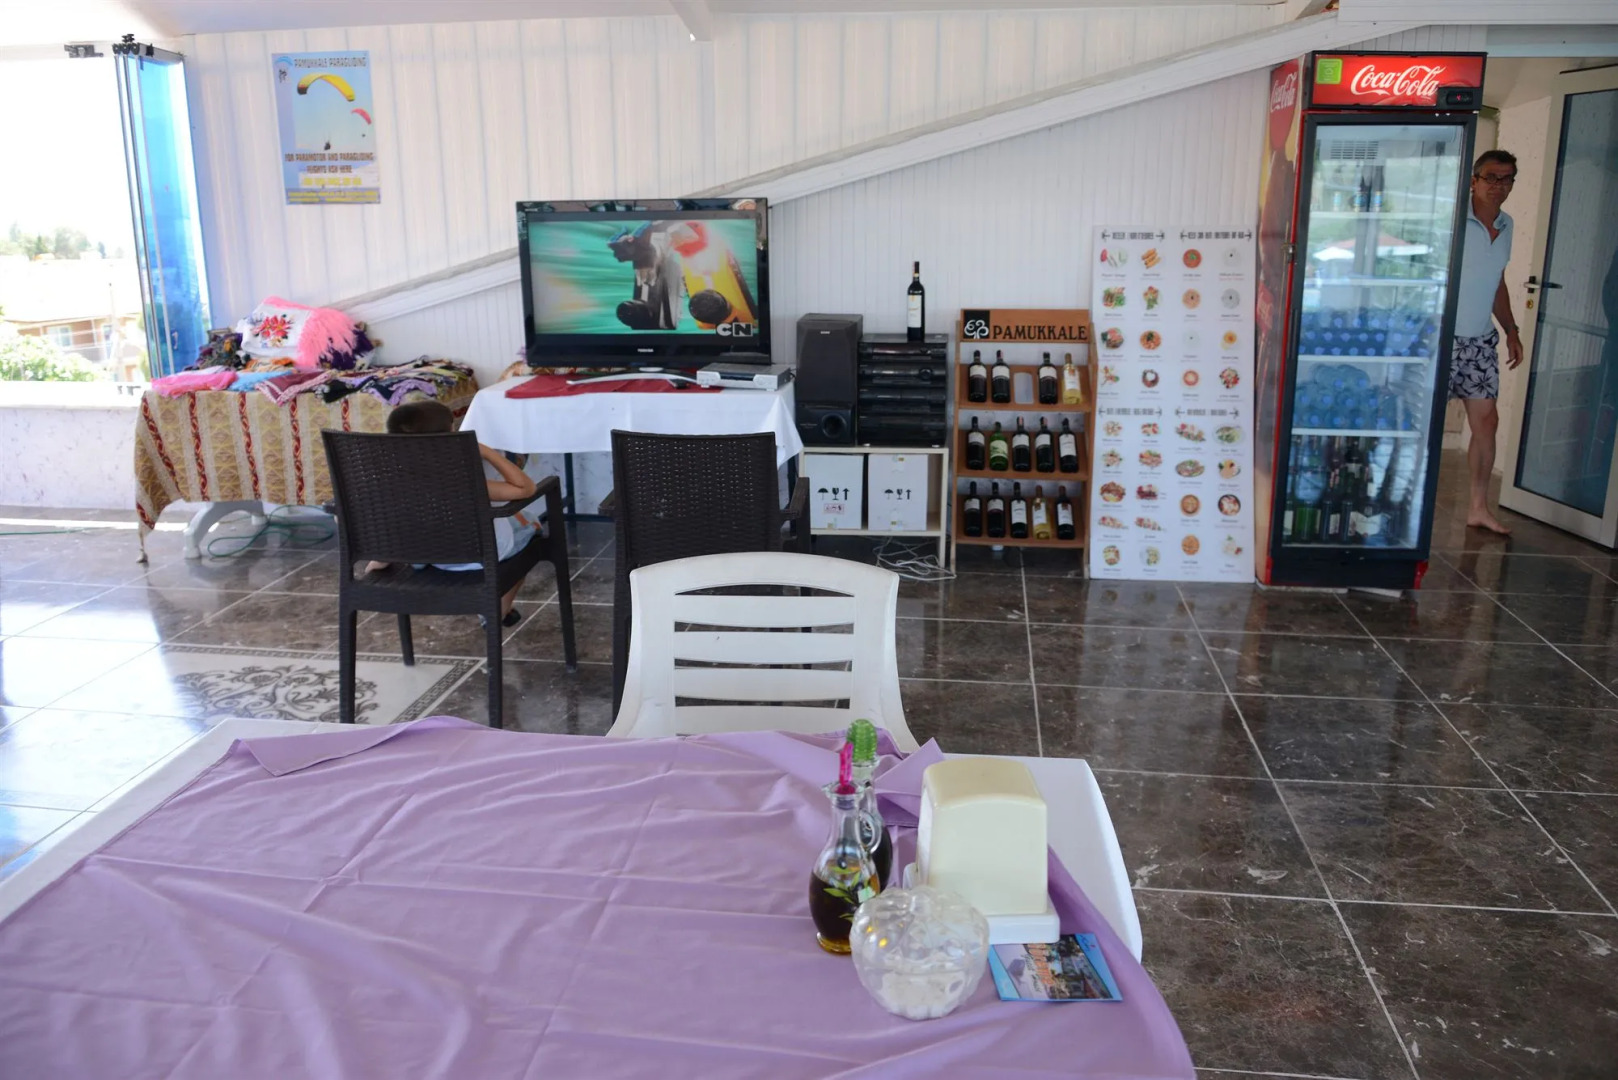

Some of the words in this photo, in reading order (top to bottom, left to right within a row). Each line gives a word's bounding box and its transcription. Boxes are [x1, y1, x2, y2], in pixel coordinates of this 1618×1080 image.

[1351, 64, 1447, 96] Coca-Cola
[716, 322, 754, 337] CN
[992, 325, 1088, 341] PAMUKKALE
